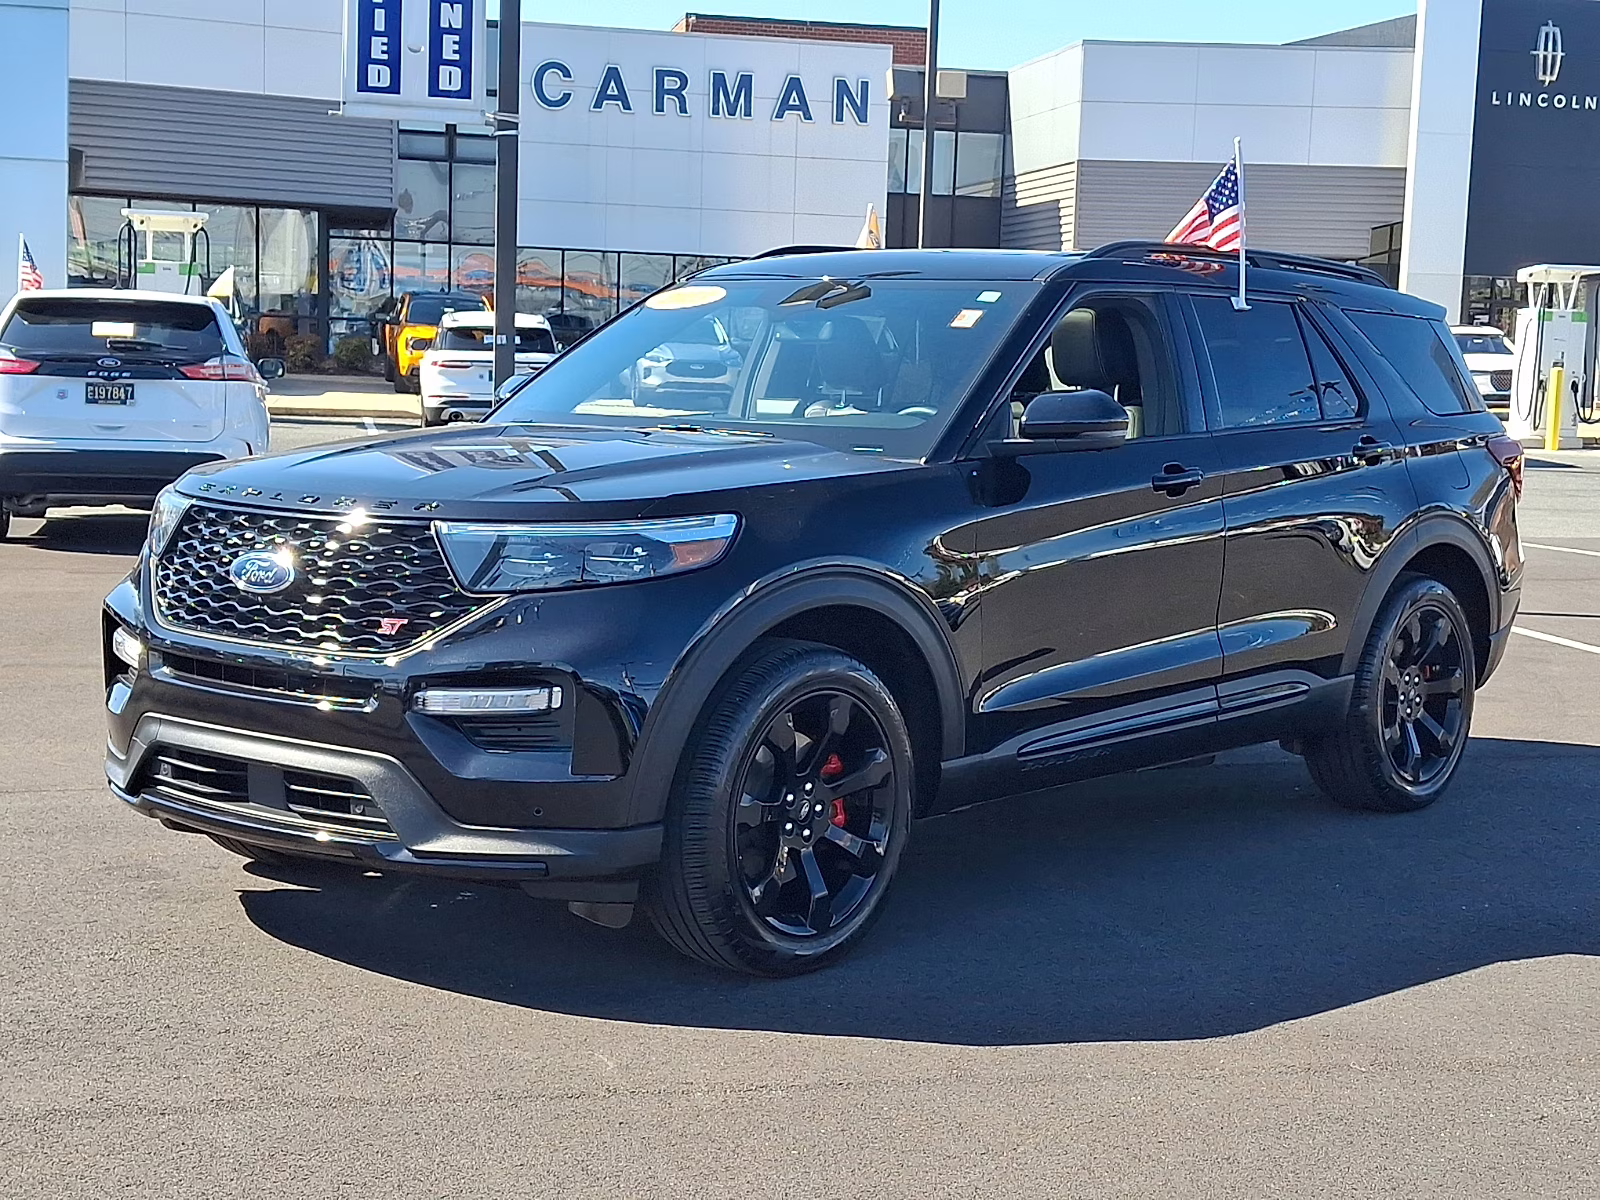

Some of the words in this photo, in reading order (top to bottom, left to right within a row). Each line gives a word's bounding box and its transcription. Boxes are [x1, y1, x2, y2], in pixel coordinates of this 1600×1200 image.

[367, 0, 391, 88] IED
[440, 2, 463, 91] NED
[531, 59, 871, 126] CARMAN
[1491, 91, 1598, 110] LINCOLN
[241, 559, 278, 583] Ford
[377, 617, 409, 635] ST
